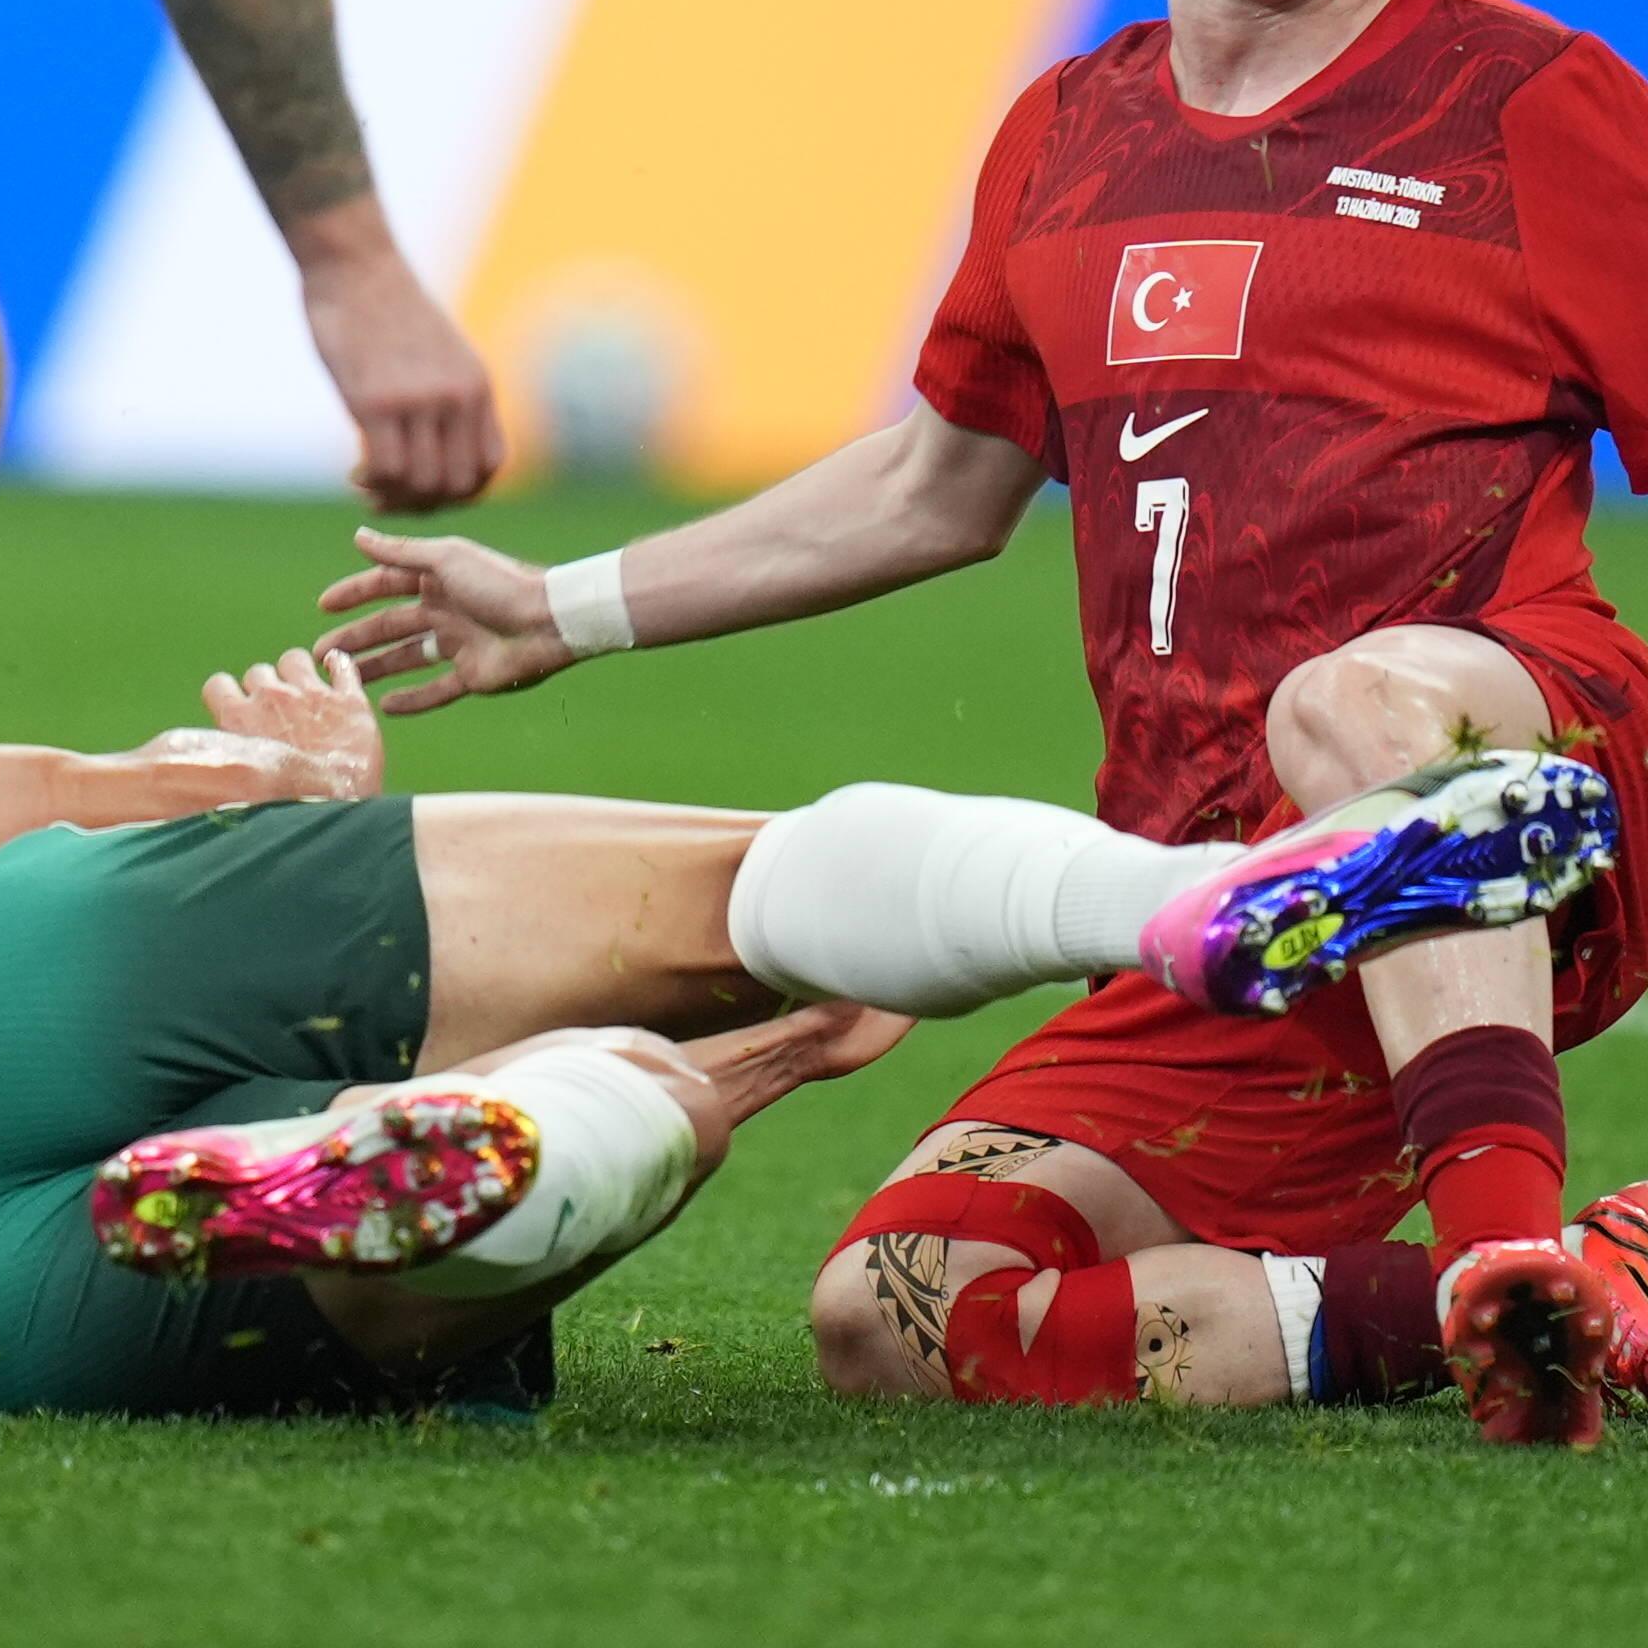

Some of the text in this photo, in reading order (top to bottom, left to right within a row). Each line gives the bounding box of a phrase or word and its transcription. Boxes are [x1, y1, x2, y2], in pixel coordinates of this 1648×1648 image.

[1335, 195, 1351, 218] 13
[1392, 206, 1422, 230] 2026
[1134, 477, 1190, 656] 7
